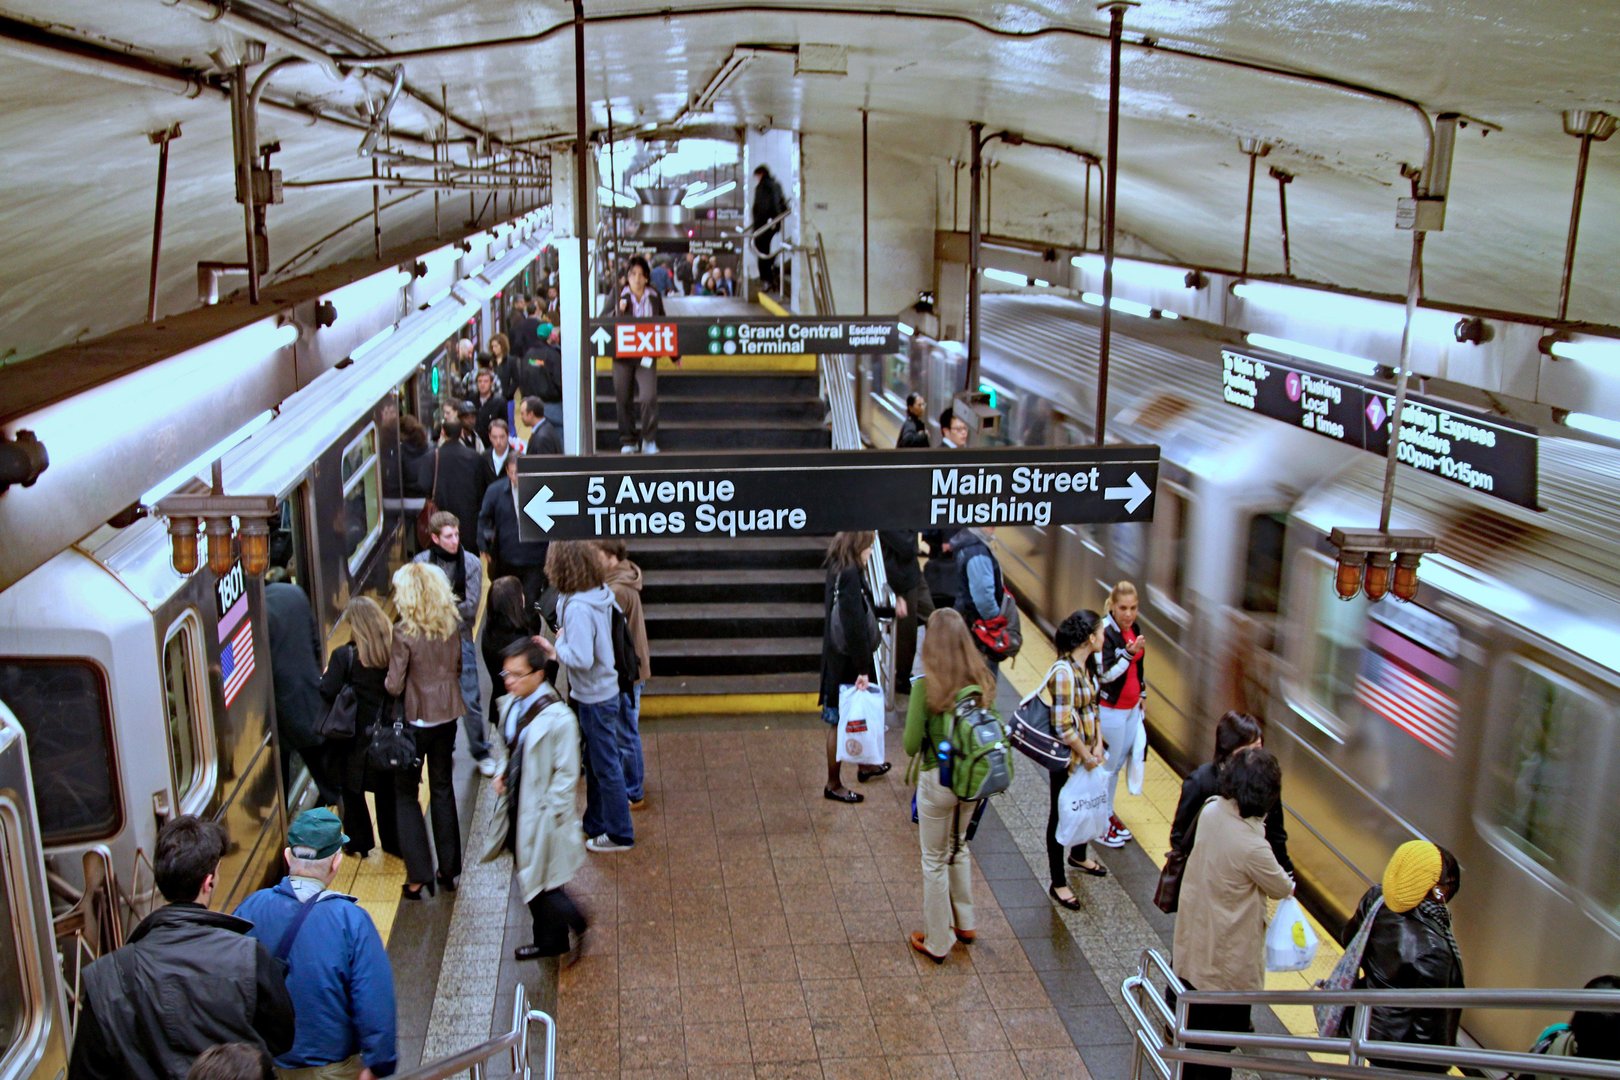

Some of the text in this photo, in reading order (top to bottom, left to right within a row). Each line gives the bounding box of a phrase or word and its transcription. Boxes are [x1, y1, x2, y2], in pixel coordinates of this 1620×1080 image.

[617, 325, 674, 352] Exit
[738, 323, 785, 339] Grand
[788, 323, 843, 339] Central
[849, 325, 891, 335] Escalator
[849, 336, 886, 347] upstairs
[739, 339, 804, 353] Terminal
[1301, 374, 1341, 404] Flushing
[1301, 392, 1328, 415] Local
[1302, 412, 1344, 438] all times
[1439, 412, 1496, 448] Express
[587, 476, 735, 505] 5 Avenue
[932, 466, 1100, 496] Main Street
[587, 504, 807, 538] Times Square
[930, 497, 1052, 526] Flushing
[218, 559, 244, 614] 1801
